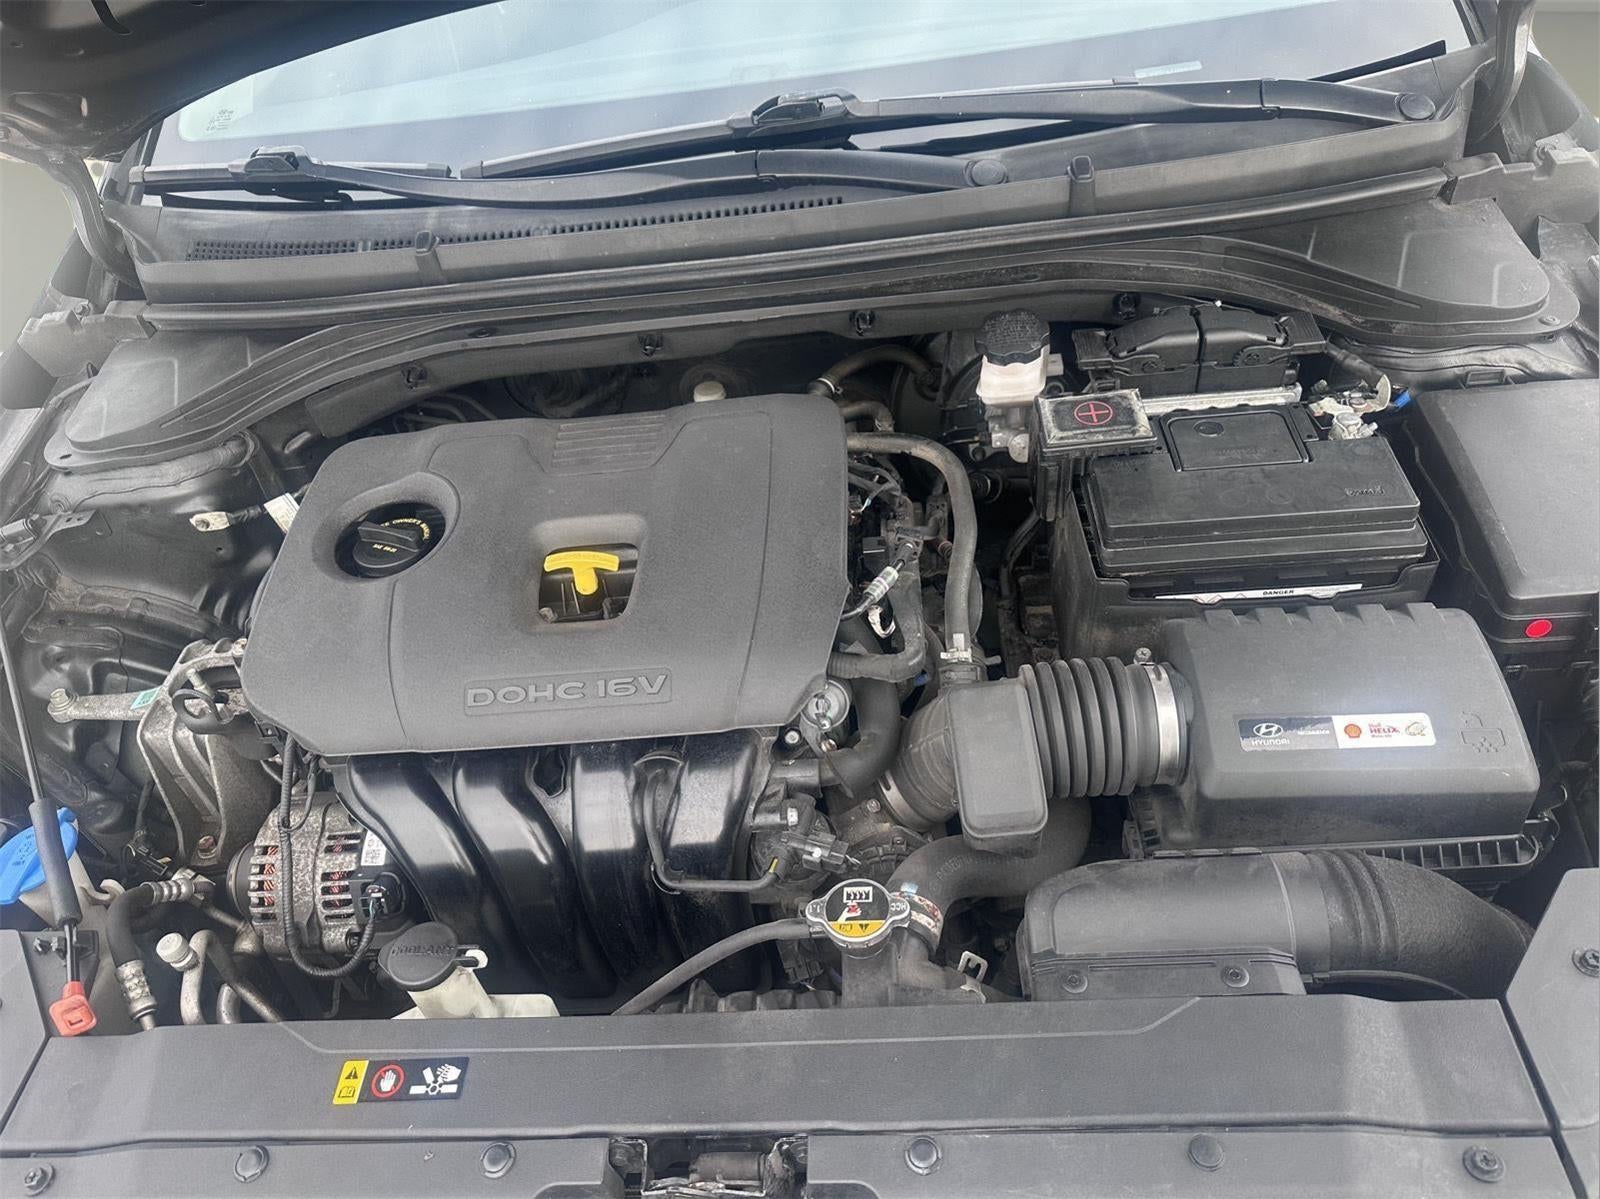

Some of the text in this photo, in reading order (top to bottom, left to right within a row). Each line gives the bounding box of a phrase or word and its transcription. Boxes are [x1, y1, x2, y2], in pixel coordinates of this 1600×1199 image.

[466, 674, 668, 707] DOHC 16V
[1251, 738, 1290, 746] HYUNDAI
